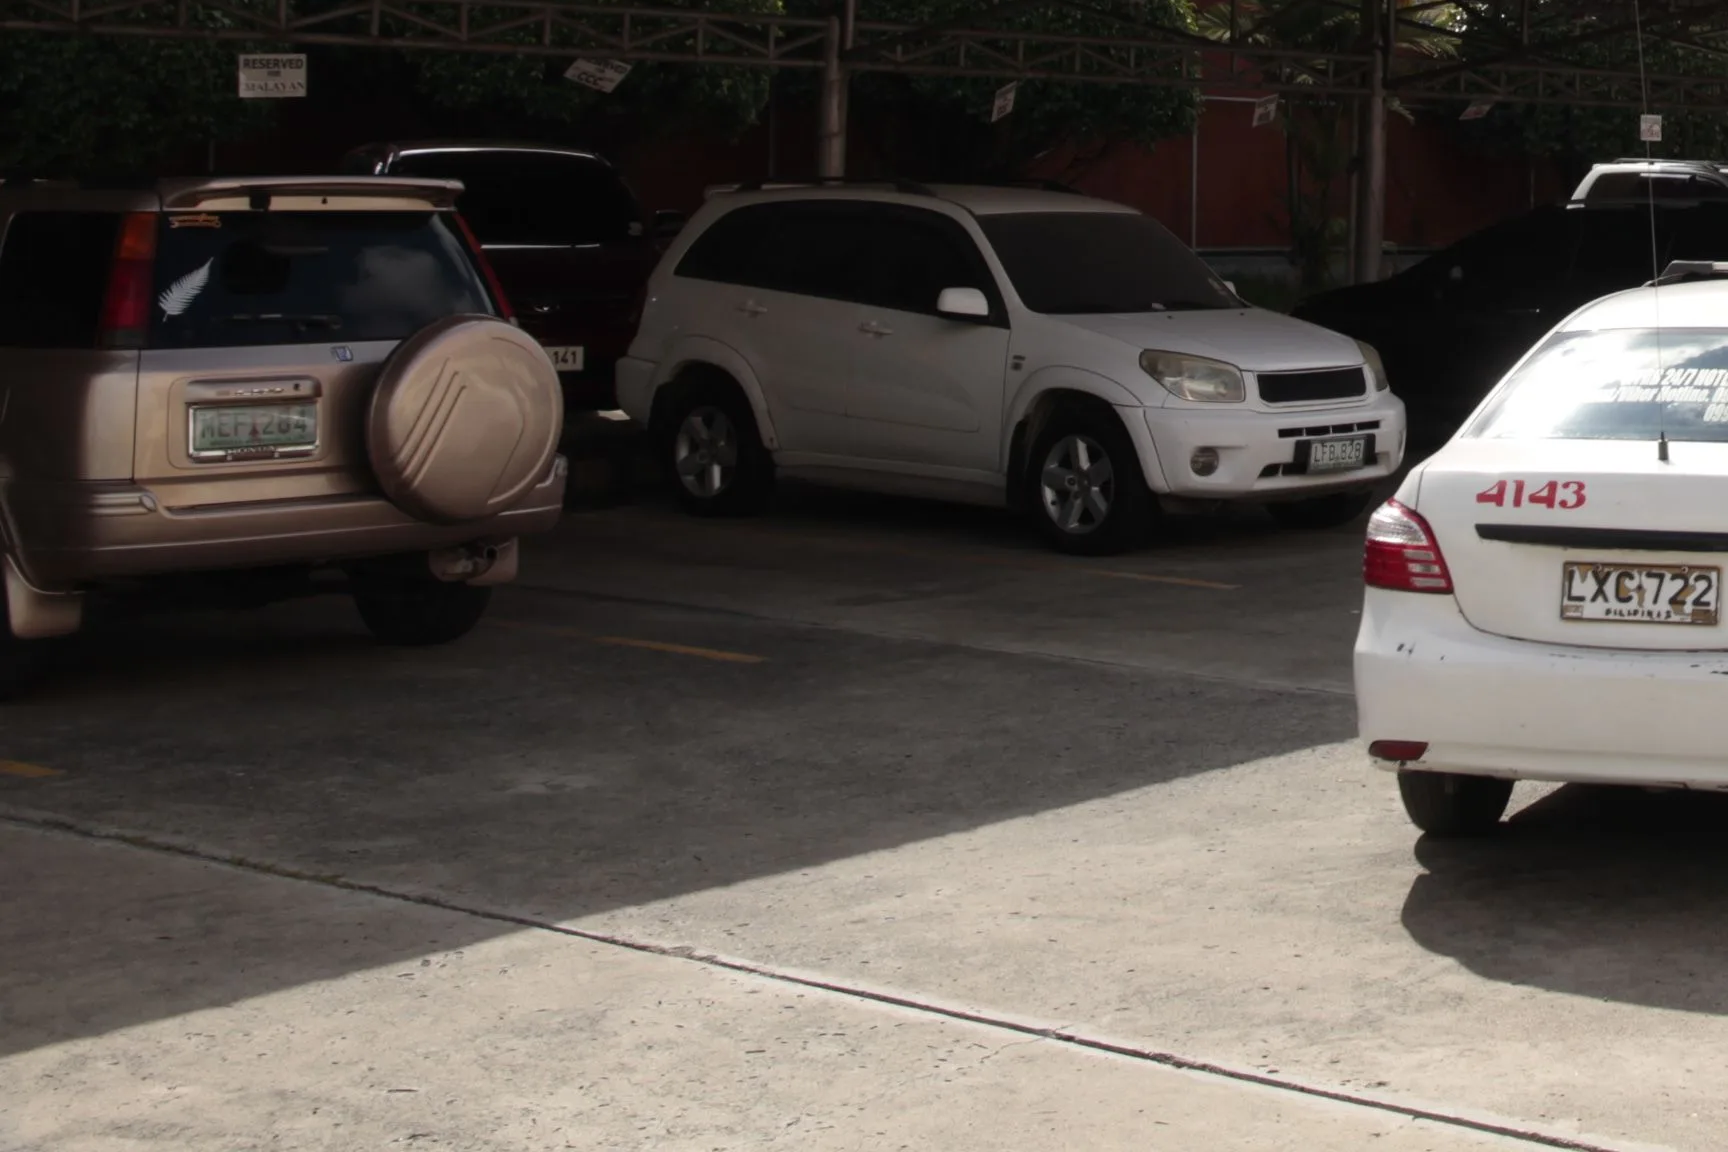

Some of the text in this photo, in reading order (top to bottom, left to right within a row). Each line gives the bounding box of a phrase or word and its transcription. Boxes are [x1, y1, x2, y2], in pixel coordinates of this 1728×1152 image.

[243, 58, 304, 70] RESERVED
[1660, 368, 1699, 386] 24/7
[1475, 479, 1586, 509] 4143
[1567, 568, 1713, 607] LXC 722
